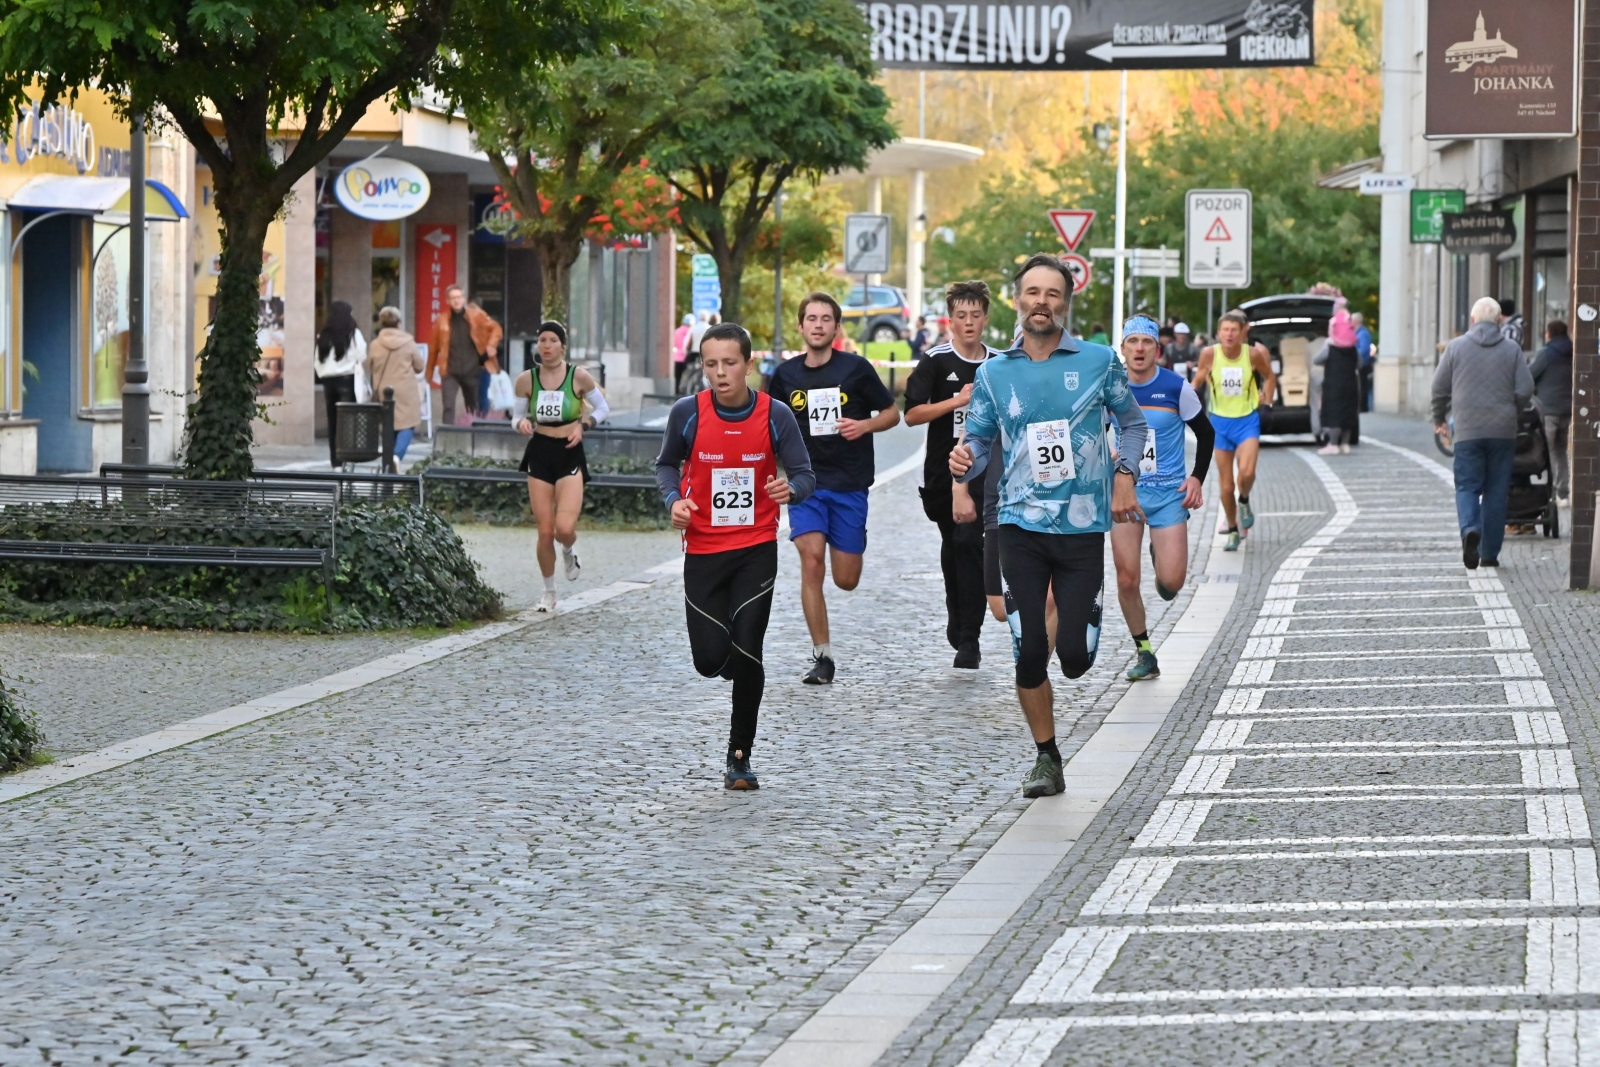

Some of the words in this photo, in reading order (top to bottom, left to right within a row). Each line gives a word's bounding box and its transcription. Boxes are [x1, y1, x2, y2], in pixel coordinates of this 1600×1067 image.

[859, 3, 1072, 64] RRRZLINU?
[1113, 22, 1171, 44] ŘEMESLNÁ
[1240, 34, 1310, 61] ICEKRAM
[1473, 76, 1555, 95] JOHANKA
[1366, 179, 1405, 187] LITEX
[1195, 198, 1243, 211] POZOR
[1222, 379, 1242, 388] 404
[537, 405, 561, 417] 485
[810, 406, 840, 422] 471
[954, 410, 968, 425] 3
[1037, 445, 1065, 466] 30
[713, 491, 753, 509] 623
